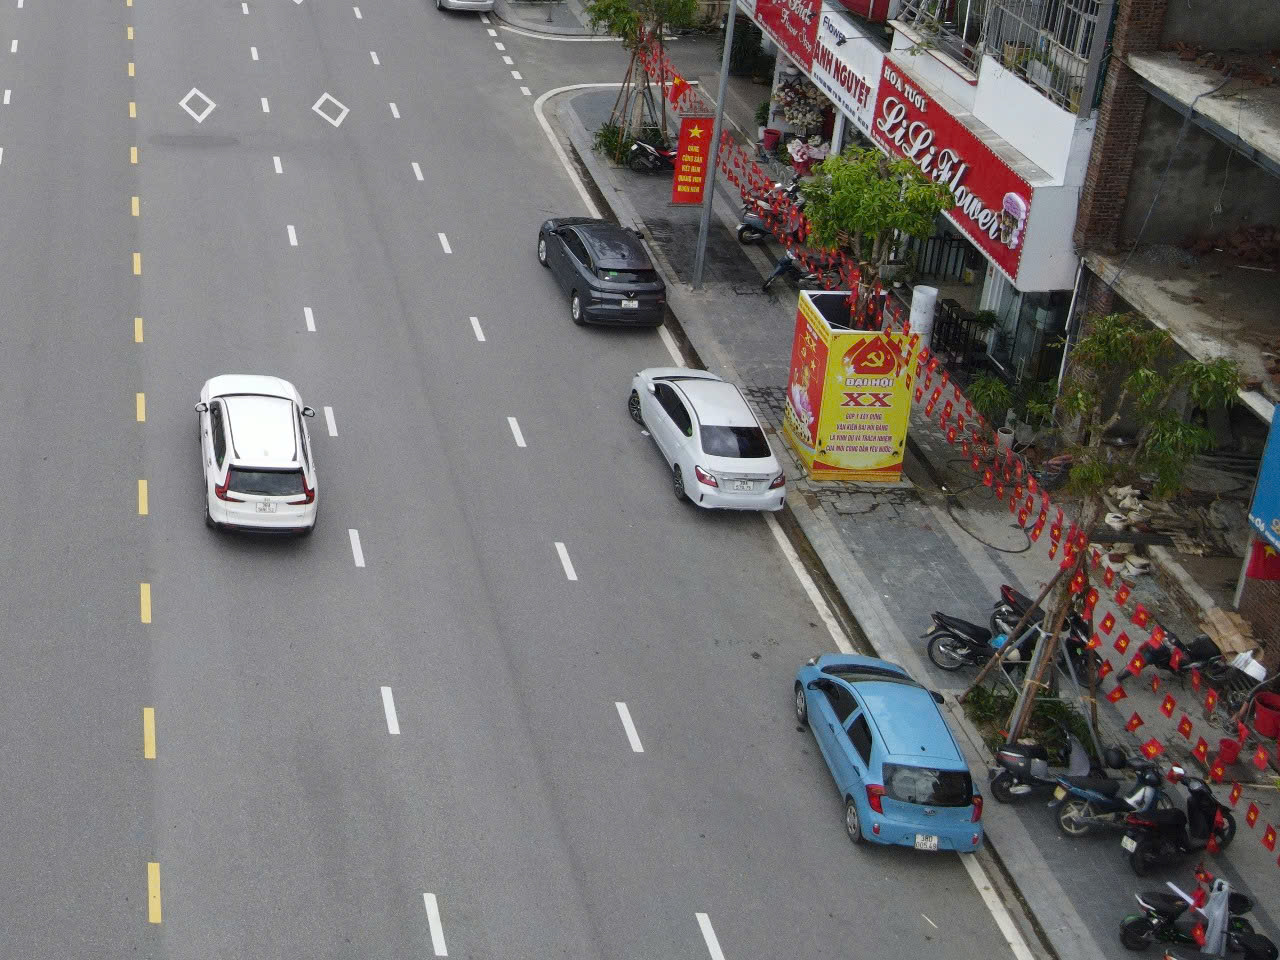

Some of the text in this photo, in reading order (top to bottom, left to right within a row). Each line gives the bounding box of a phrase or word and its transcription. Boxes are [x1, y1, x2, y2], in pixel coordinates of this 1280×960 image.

[833, 56, 872, 112] NGUYỆT
[883, 66, 903, 92] HOA
[845, 377, 894, 388] ĐẠI HỘI
[840, 392, 893, 407] XX
